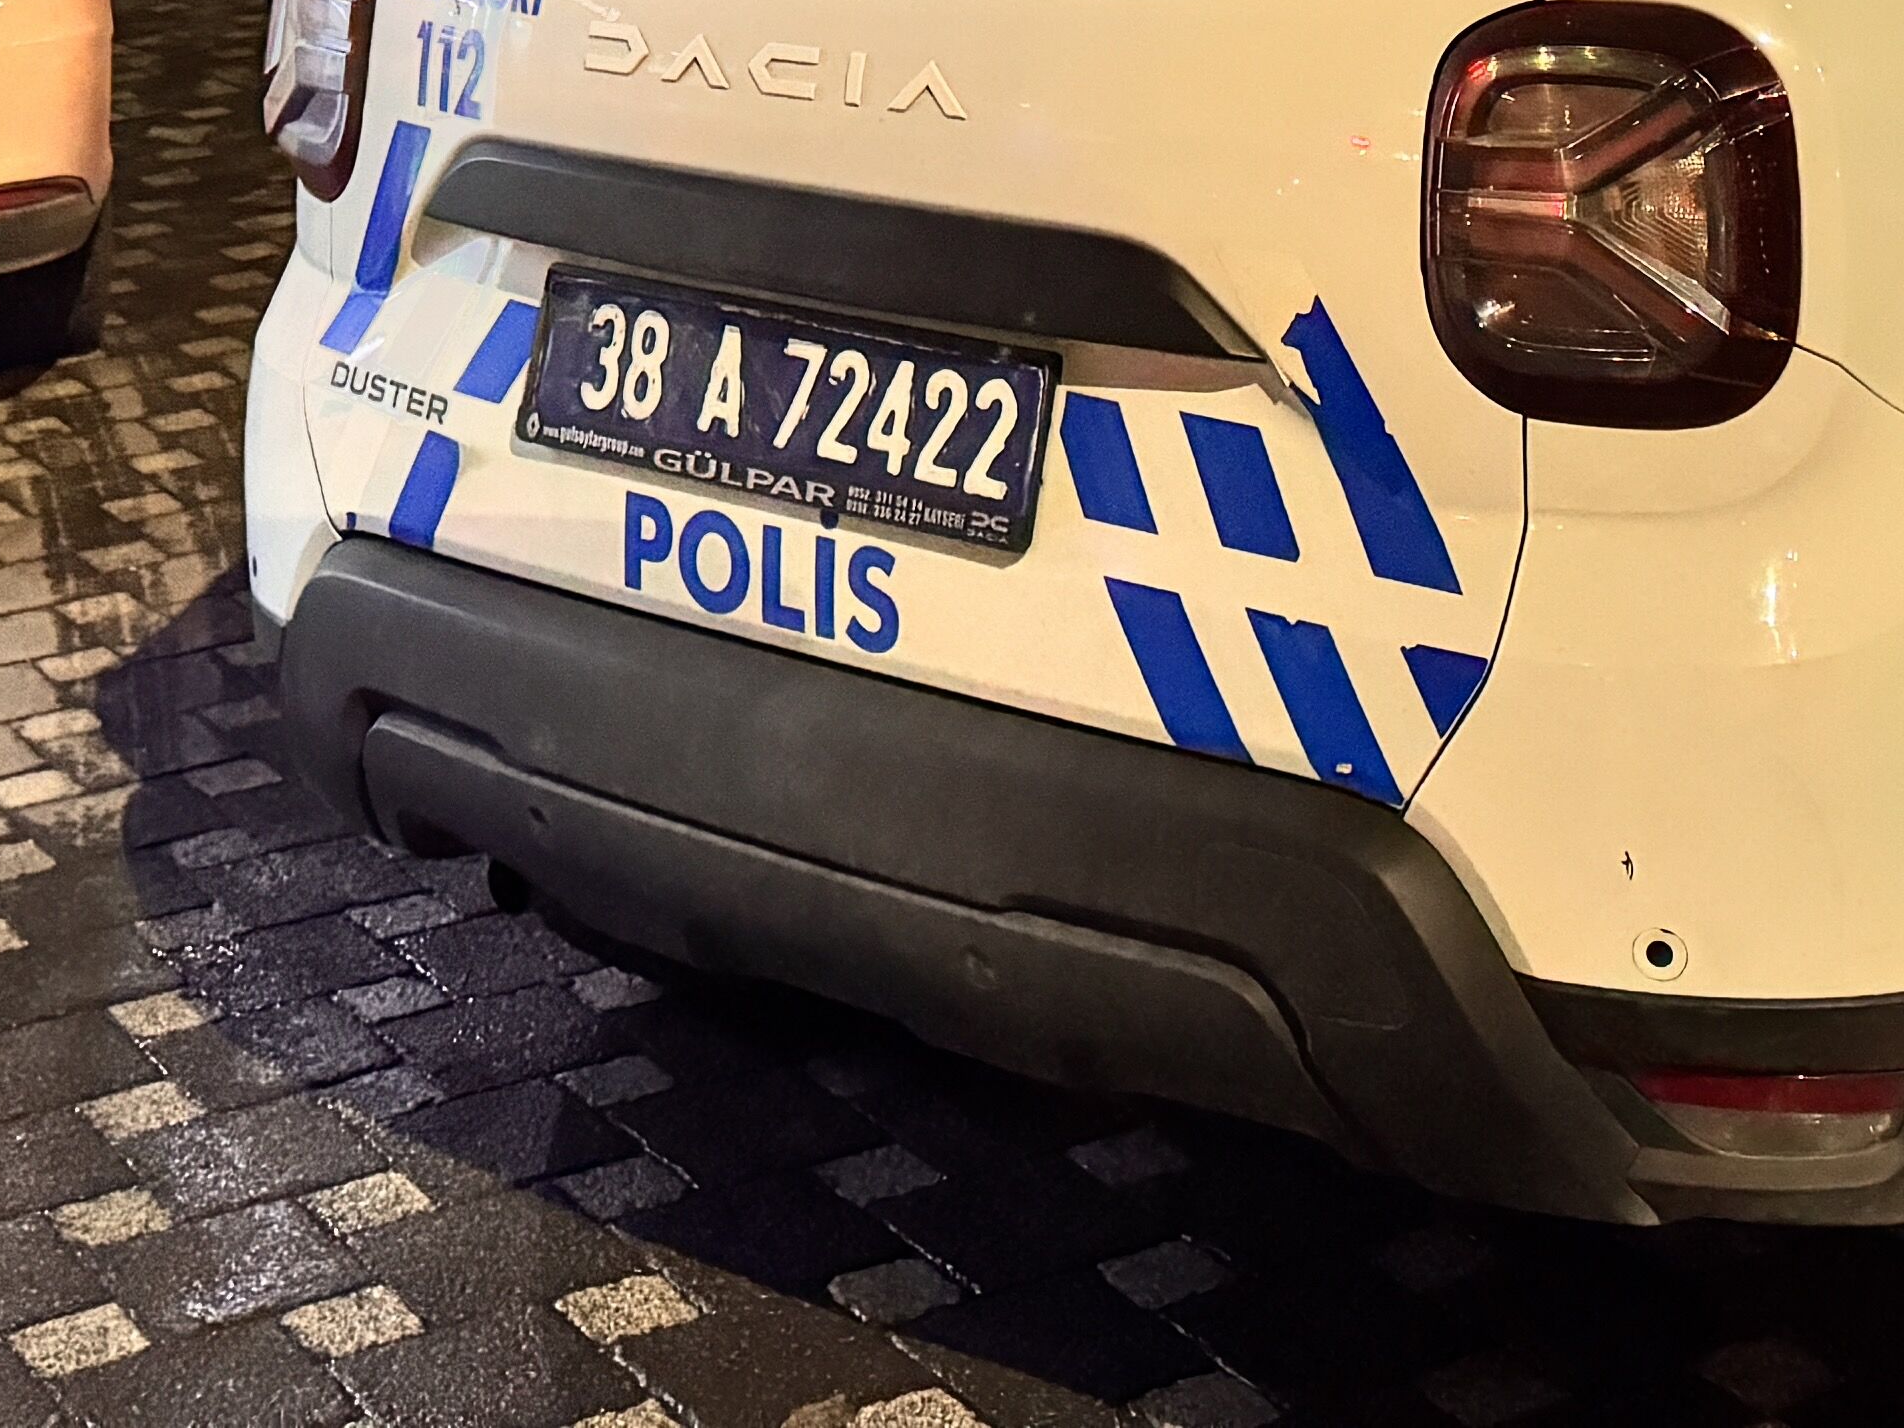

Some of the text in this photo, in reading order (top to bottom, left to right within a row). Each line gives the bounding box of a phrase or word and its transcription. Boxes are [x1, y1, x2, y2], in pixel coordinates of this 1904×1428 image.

[416, 20, 486, 120] 112
[583, 19, 968, 121] DACIA
[330, 361, 449, 425] DUSTER
[580, 303, 1020, 501] 38 A 72422
[653, 447, 835, 508] GÜLPAR
[625, 491, 898, 654] POLİS
